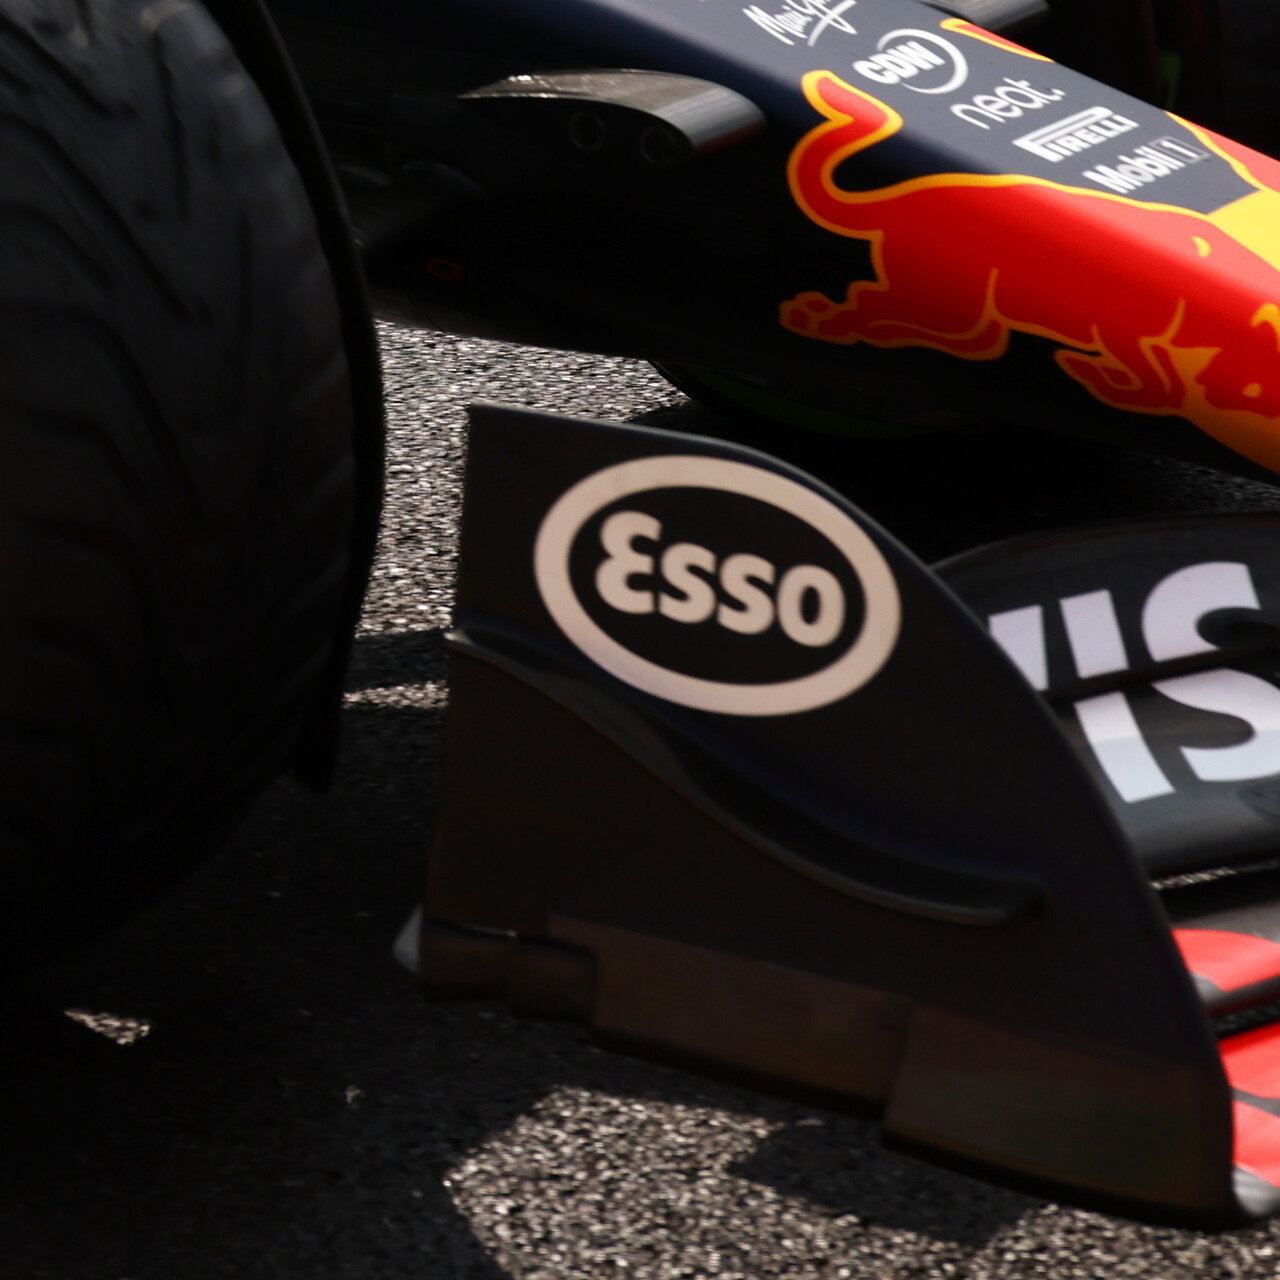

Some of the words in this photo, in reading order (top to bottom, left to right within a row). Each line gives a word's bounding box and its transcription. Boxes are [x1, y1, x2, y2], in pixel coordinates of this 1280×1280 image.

[853, 41, 945, 84] CDW
[1011, 106, 1139, 163] PIRELLI
[1082, 145, 1186, 194] Mobil
